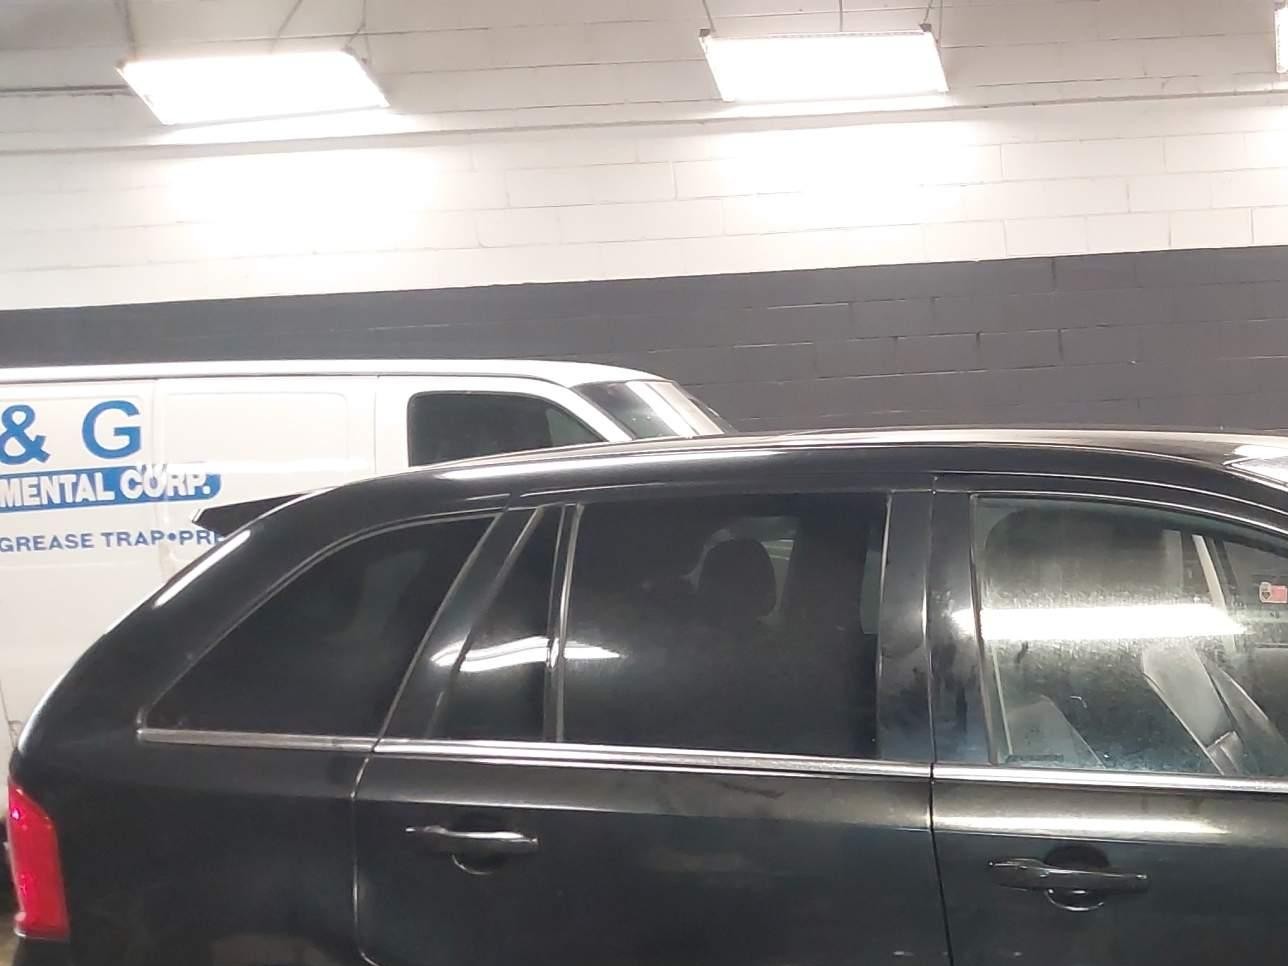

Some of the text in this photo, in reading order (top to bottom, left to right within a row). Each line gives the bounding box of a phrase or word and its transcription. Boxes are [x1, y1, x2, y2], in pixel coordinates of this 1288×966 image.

[0, 400, 141, 464] & G
[0, 468, 211, 508] MENTAL CORP.
[0, 532, 95, 552] GREASE
